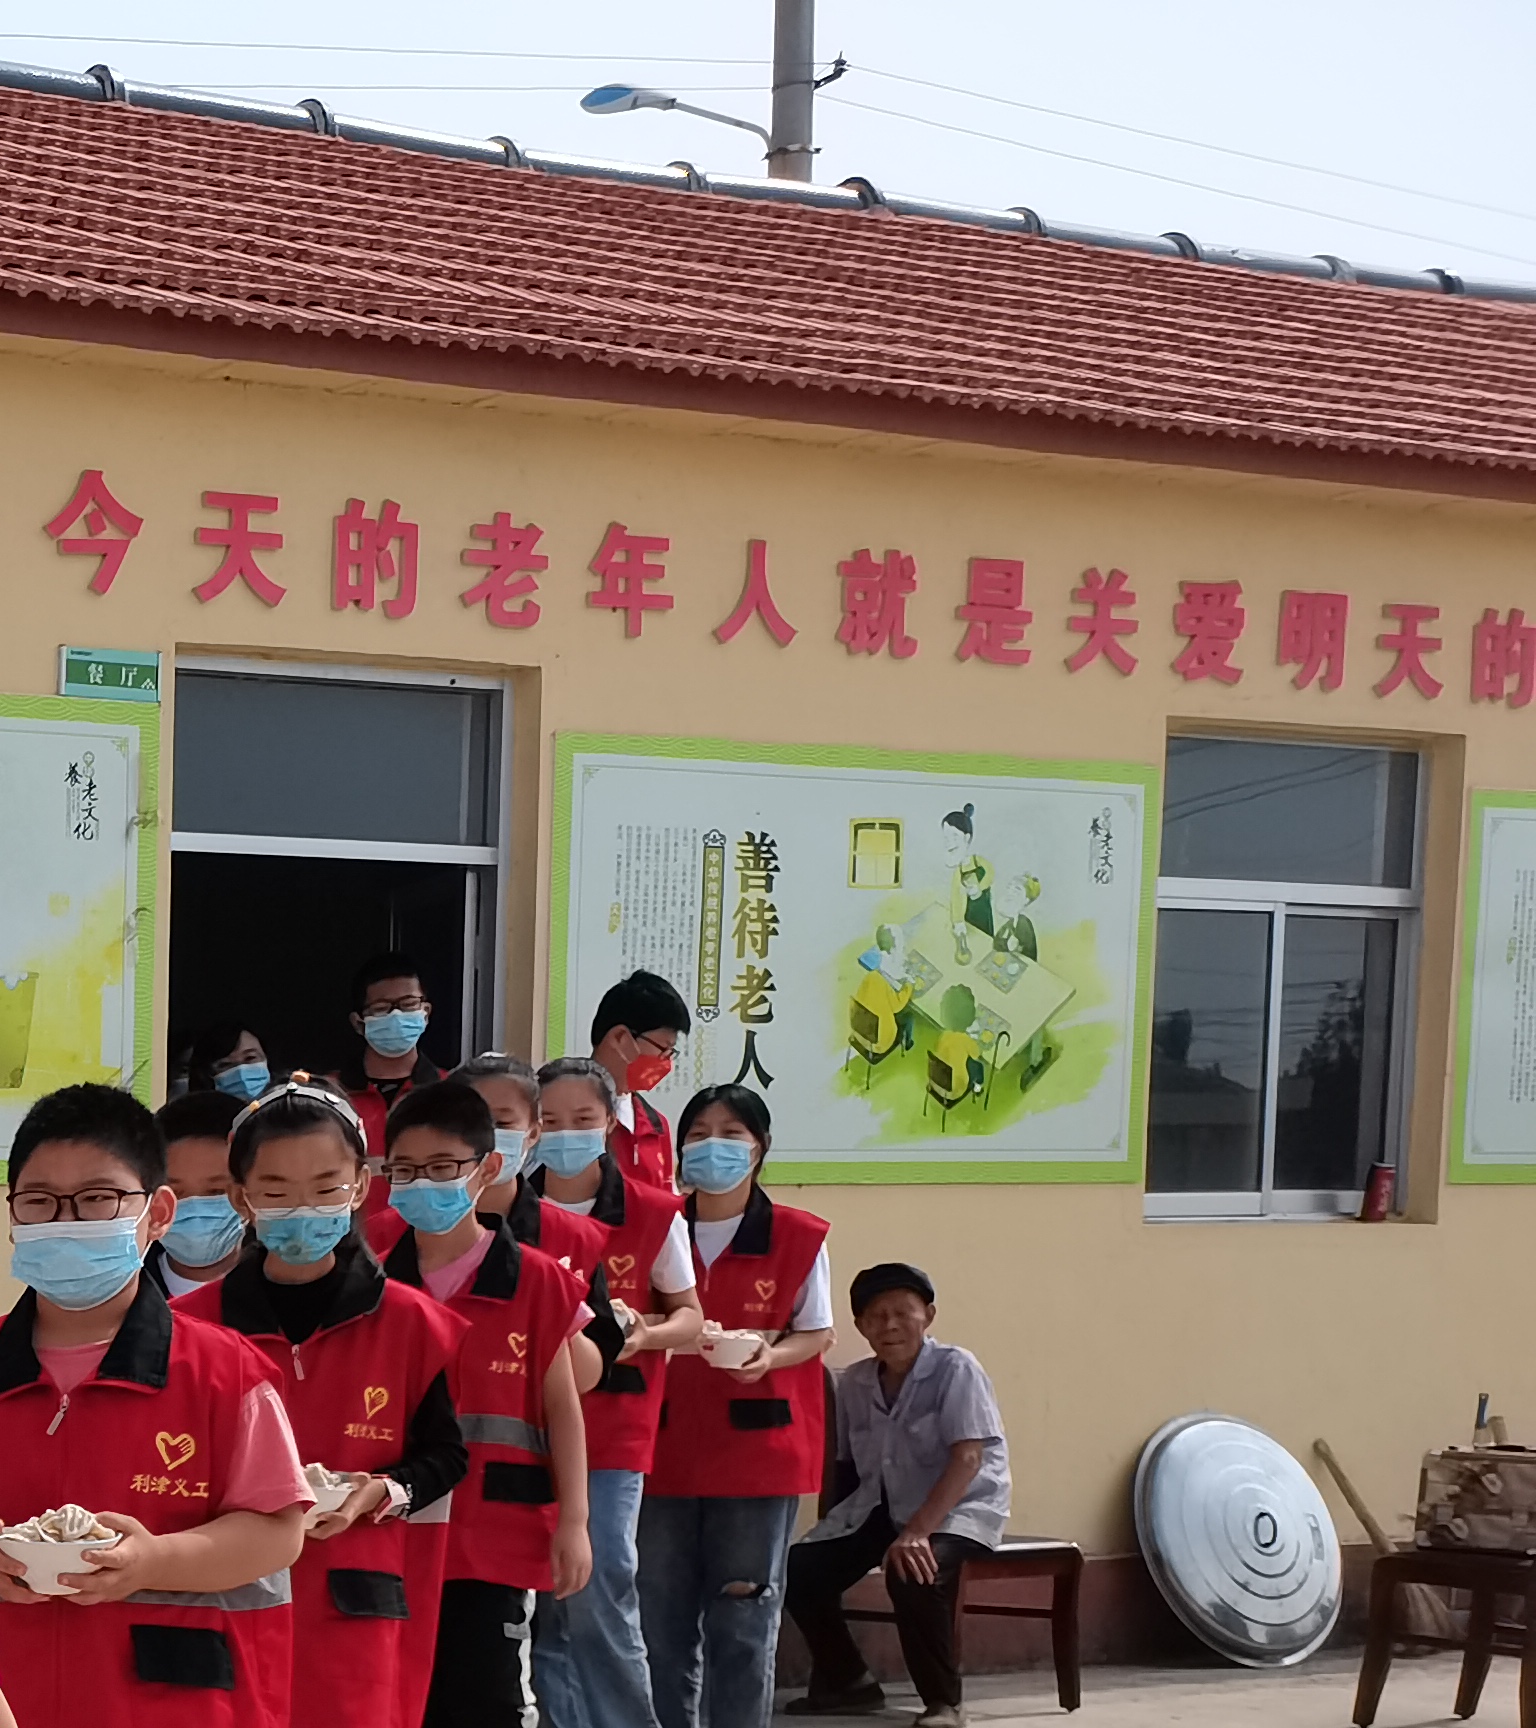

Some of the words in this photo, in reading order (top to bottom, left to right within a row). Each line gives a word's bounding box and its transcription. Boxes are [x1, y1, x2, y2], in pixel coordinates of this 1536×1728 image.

[87, 662, 138, 686] 餐厅
[729, 830, 781, 1090] 善待老人
[130, 1474, 209, 1498] 利津义工
